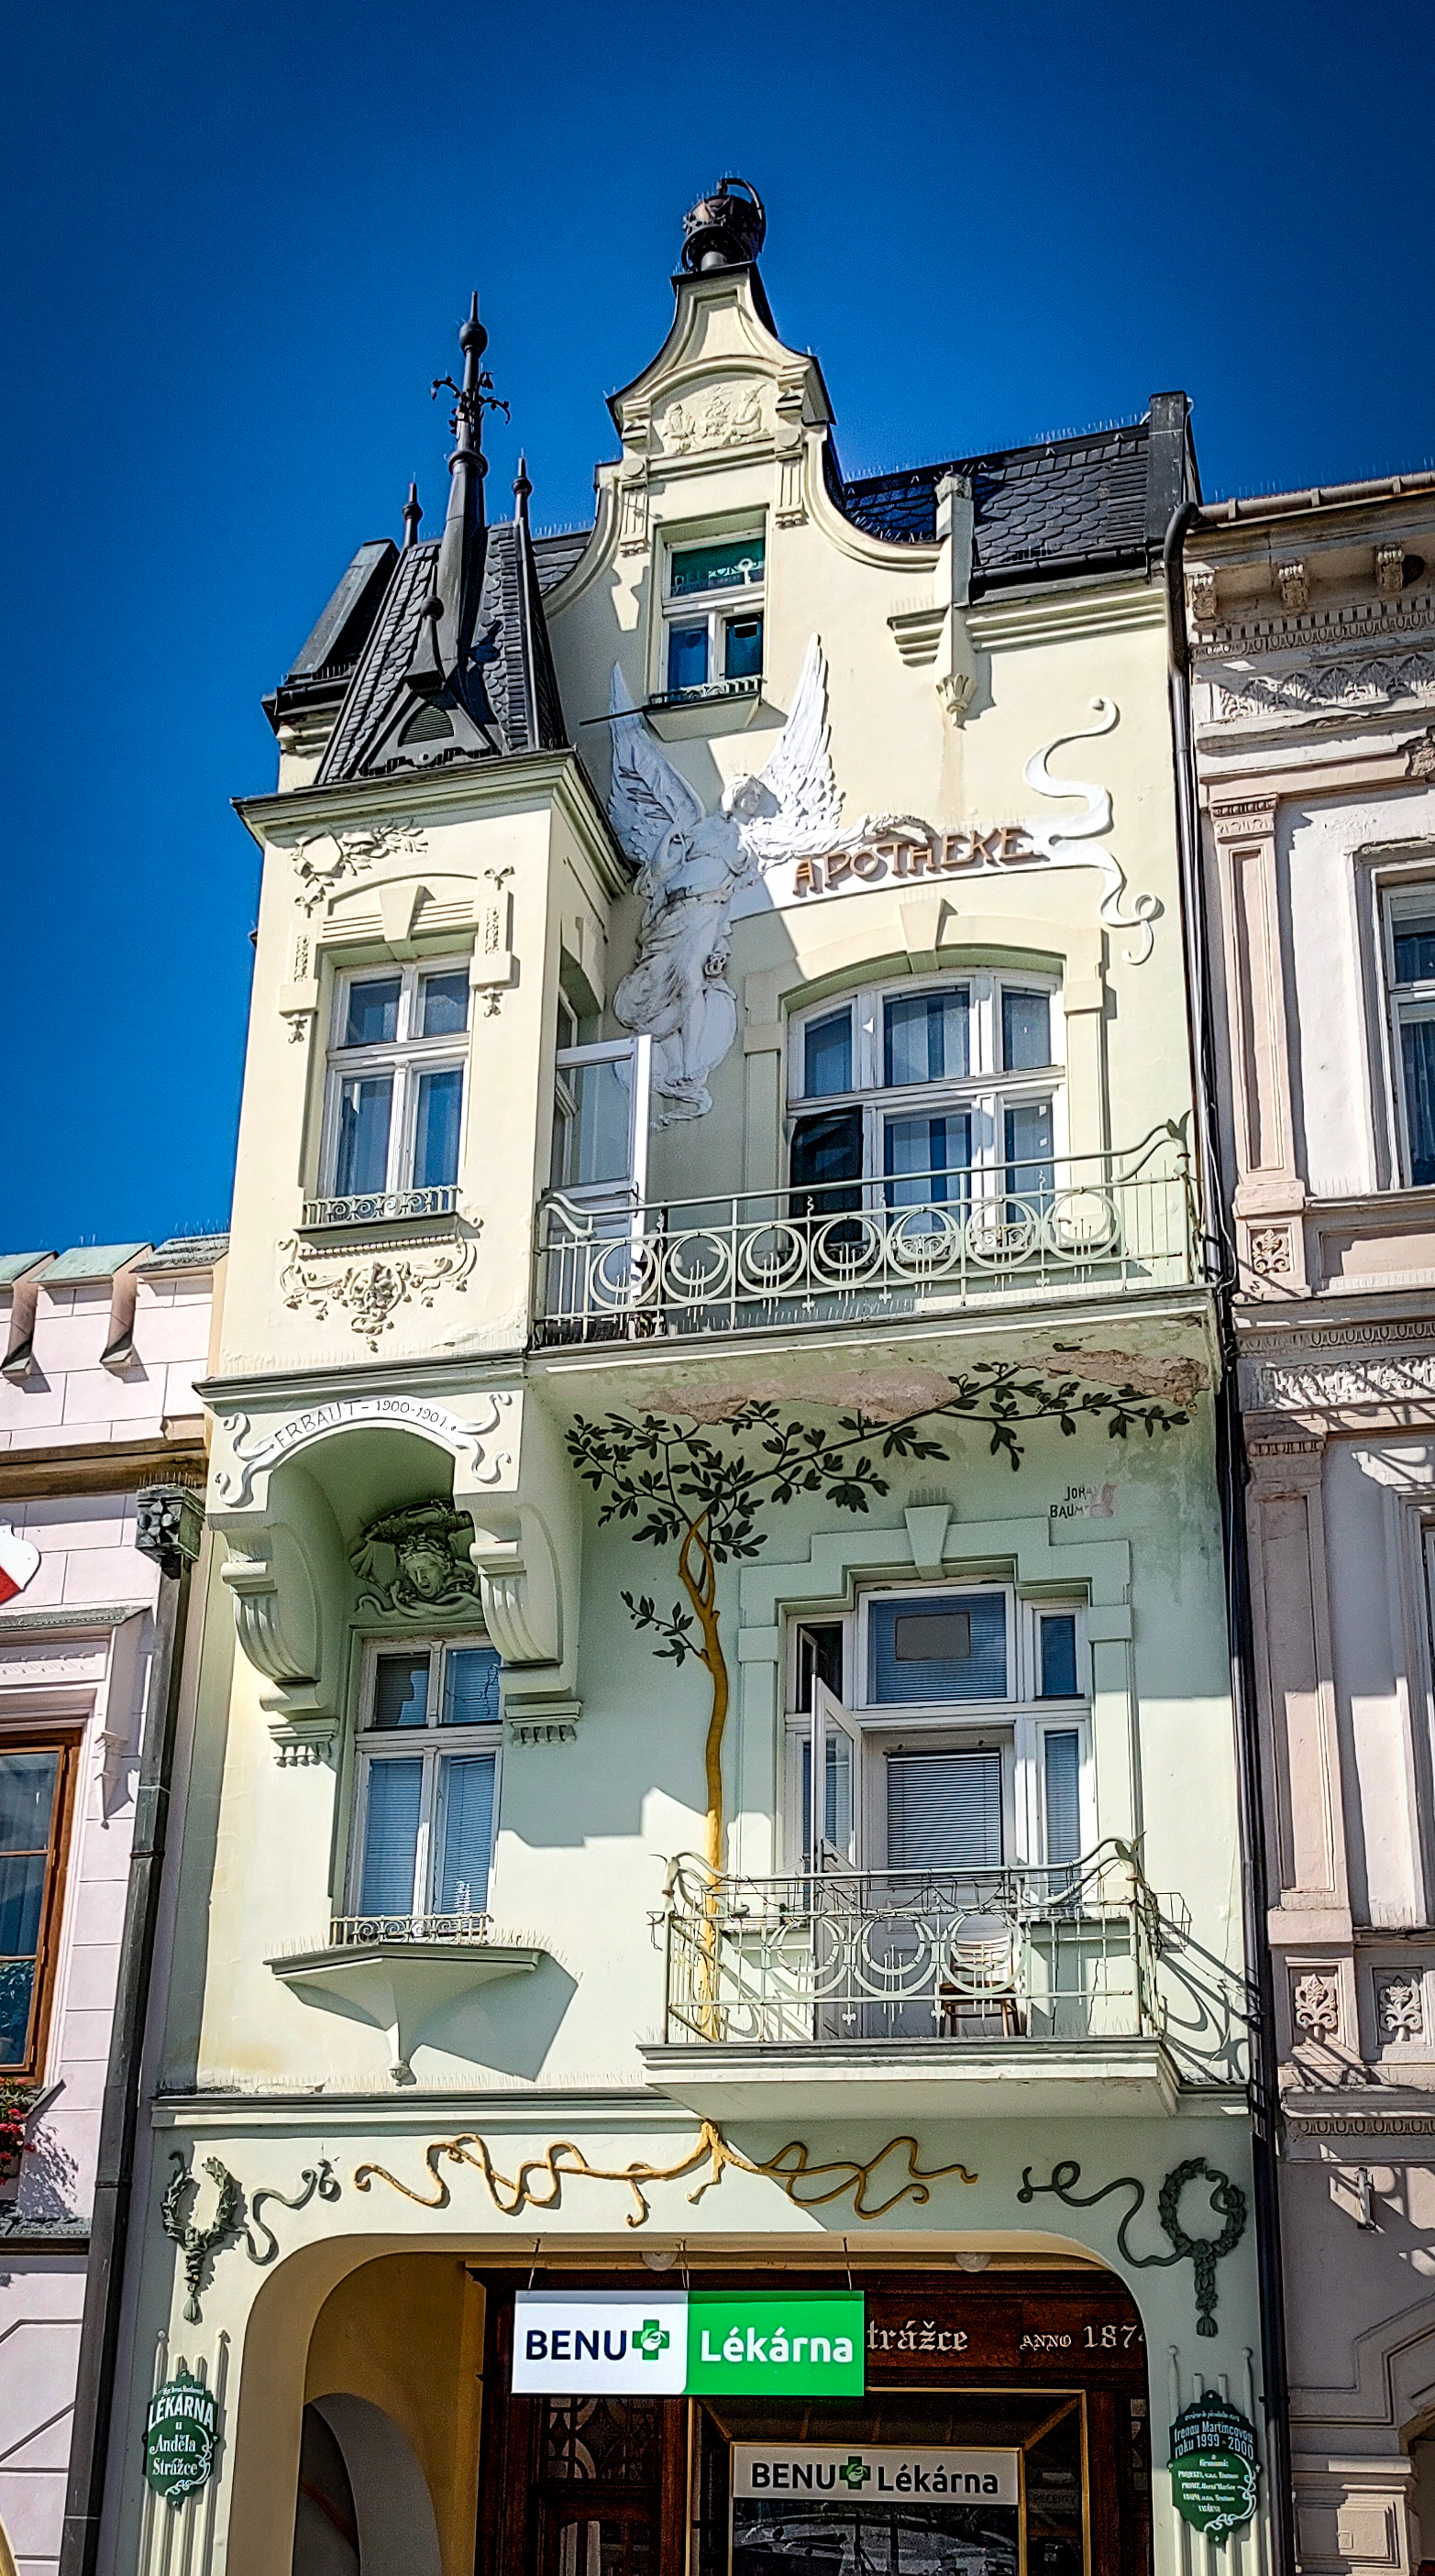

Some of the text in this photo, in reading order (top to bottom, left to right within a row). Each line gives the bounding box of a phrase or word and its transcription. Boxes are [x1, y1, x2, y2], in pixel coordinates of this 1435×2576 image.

[792, 826, 1036, 897] APOTHEKE
[274, 1400, 362, 1449] ERBAUT
[525, 2326, 854, 2362] BENU Lékárna
[1020, 2333, 1072, 2351] ANNO
[148, 2394, 214, 2433] LÉKÁRNA
[149, 2434, 196, 2455] Anděla
[1175, 2438, 1194, 2460] roku
[1197, 2433, 1220, 2448] 1999
[1228, 2436, 1253, 2460] 2000
[152, 2457, 198, 2475] Strážce
[751, 2462, 999, 2494] BENU Lékárna
